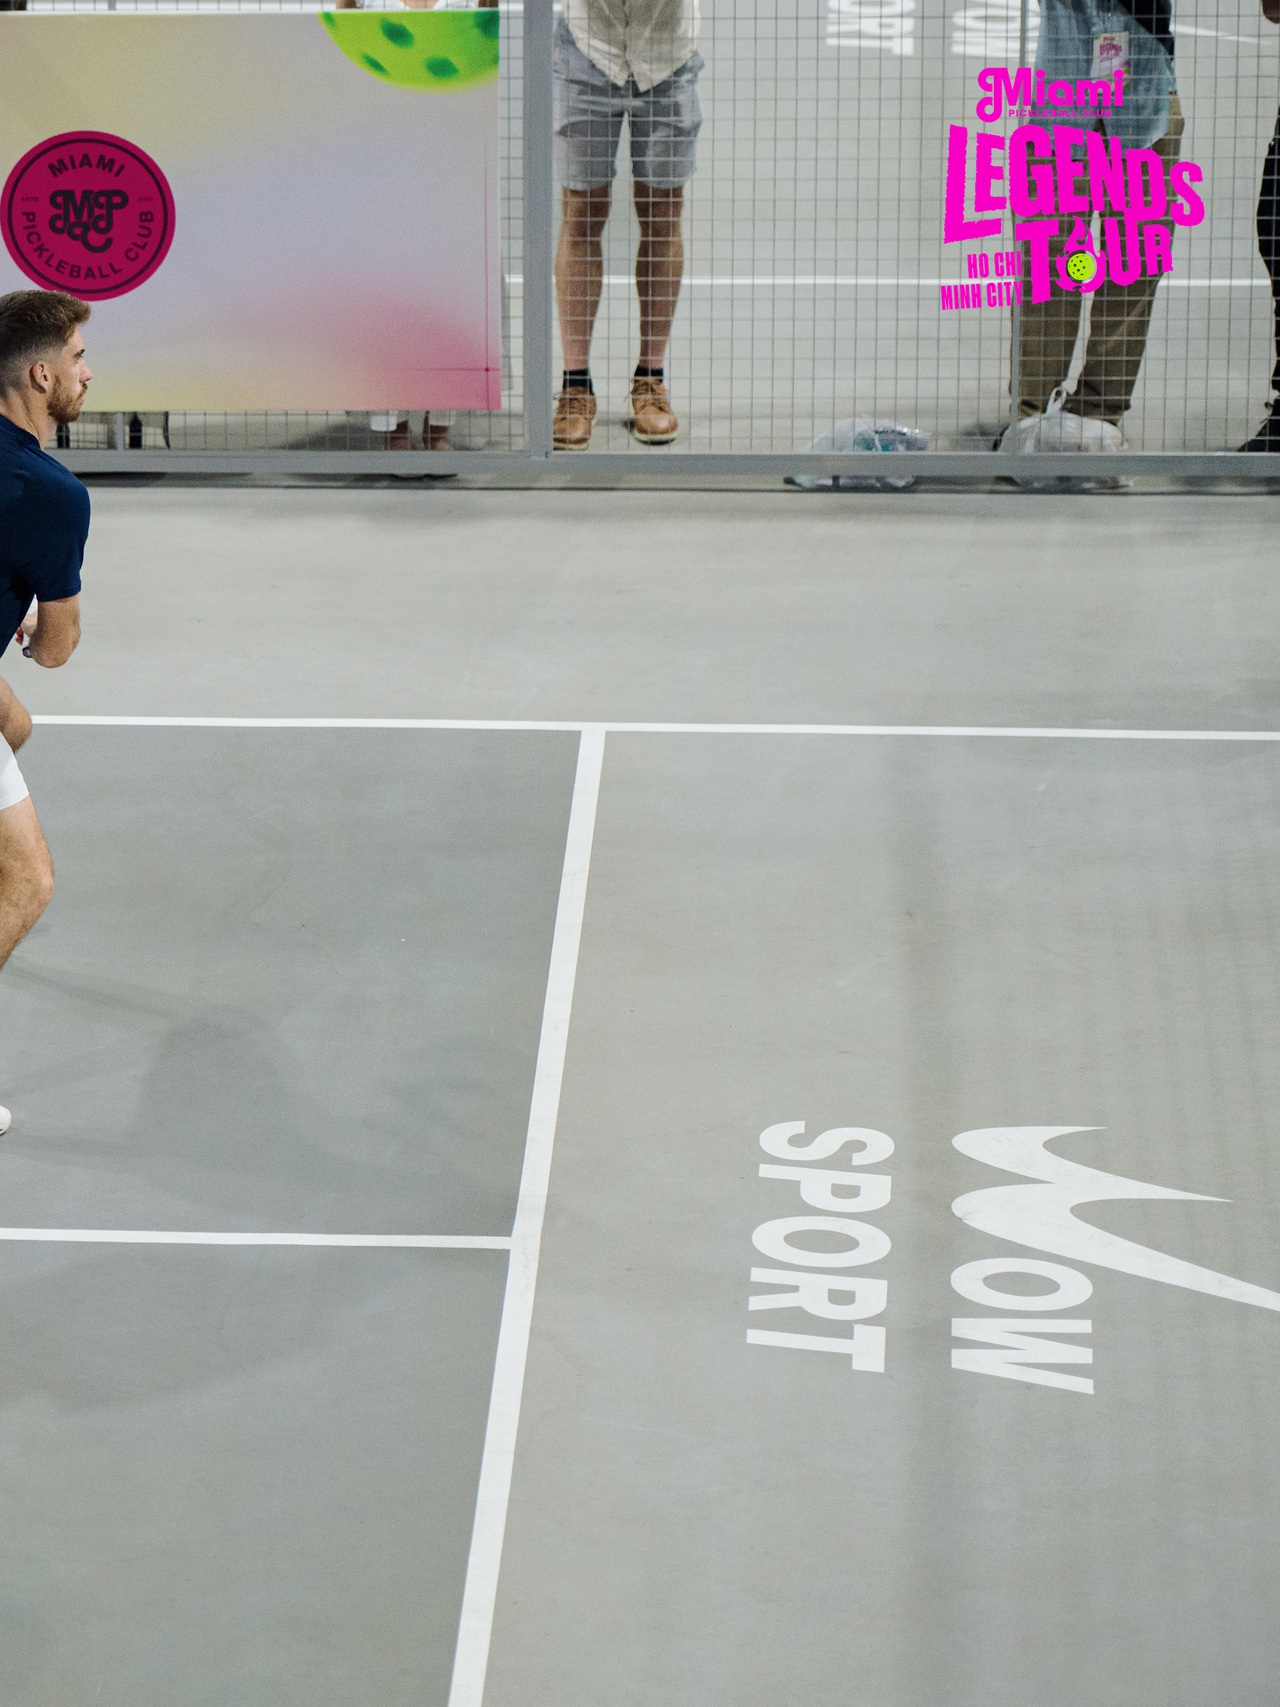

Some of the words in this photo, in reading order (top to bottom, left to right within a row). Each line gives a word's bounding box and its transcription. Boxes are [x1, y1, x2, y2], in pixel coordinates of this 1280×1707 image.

[48, 153, 125, 177] MIAMI
[21, 211, 123, 280] PICKLEBALL
[124, 211, 154, 262] CLUB
[746, 1120, 895, 1373] SPORT
